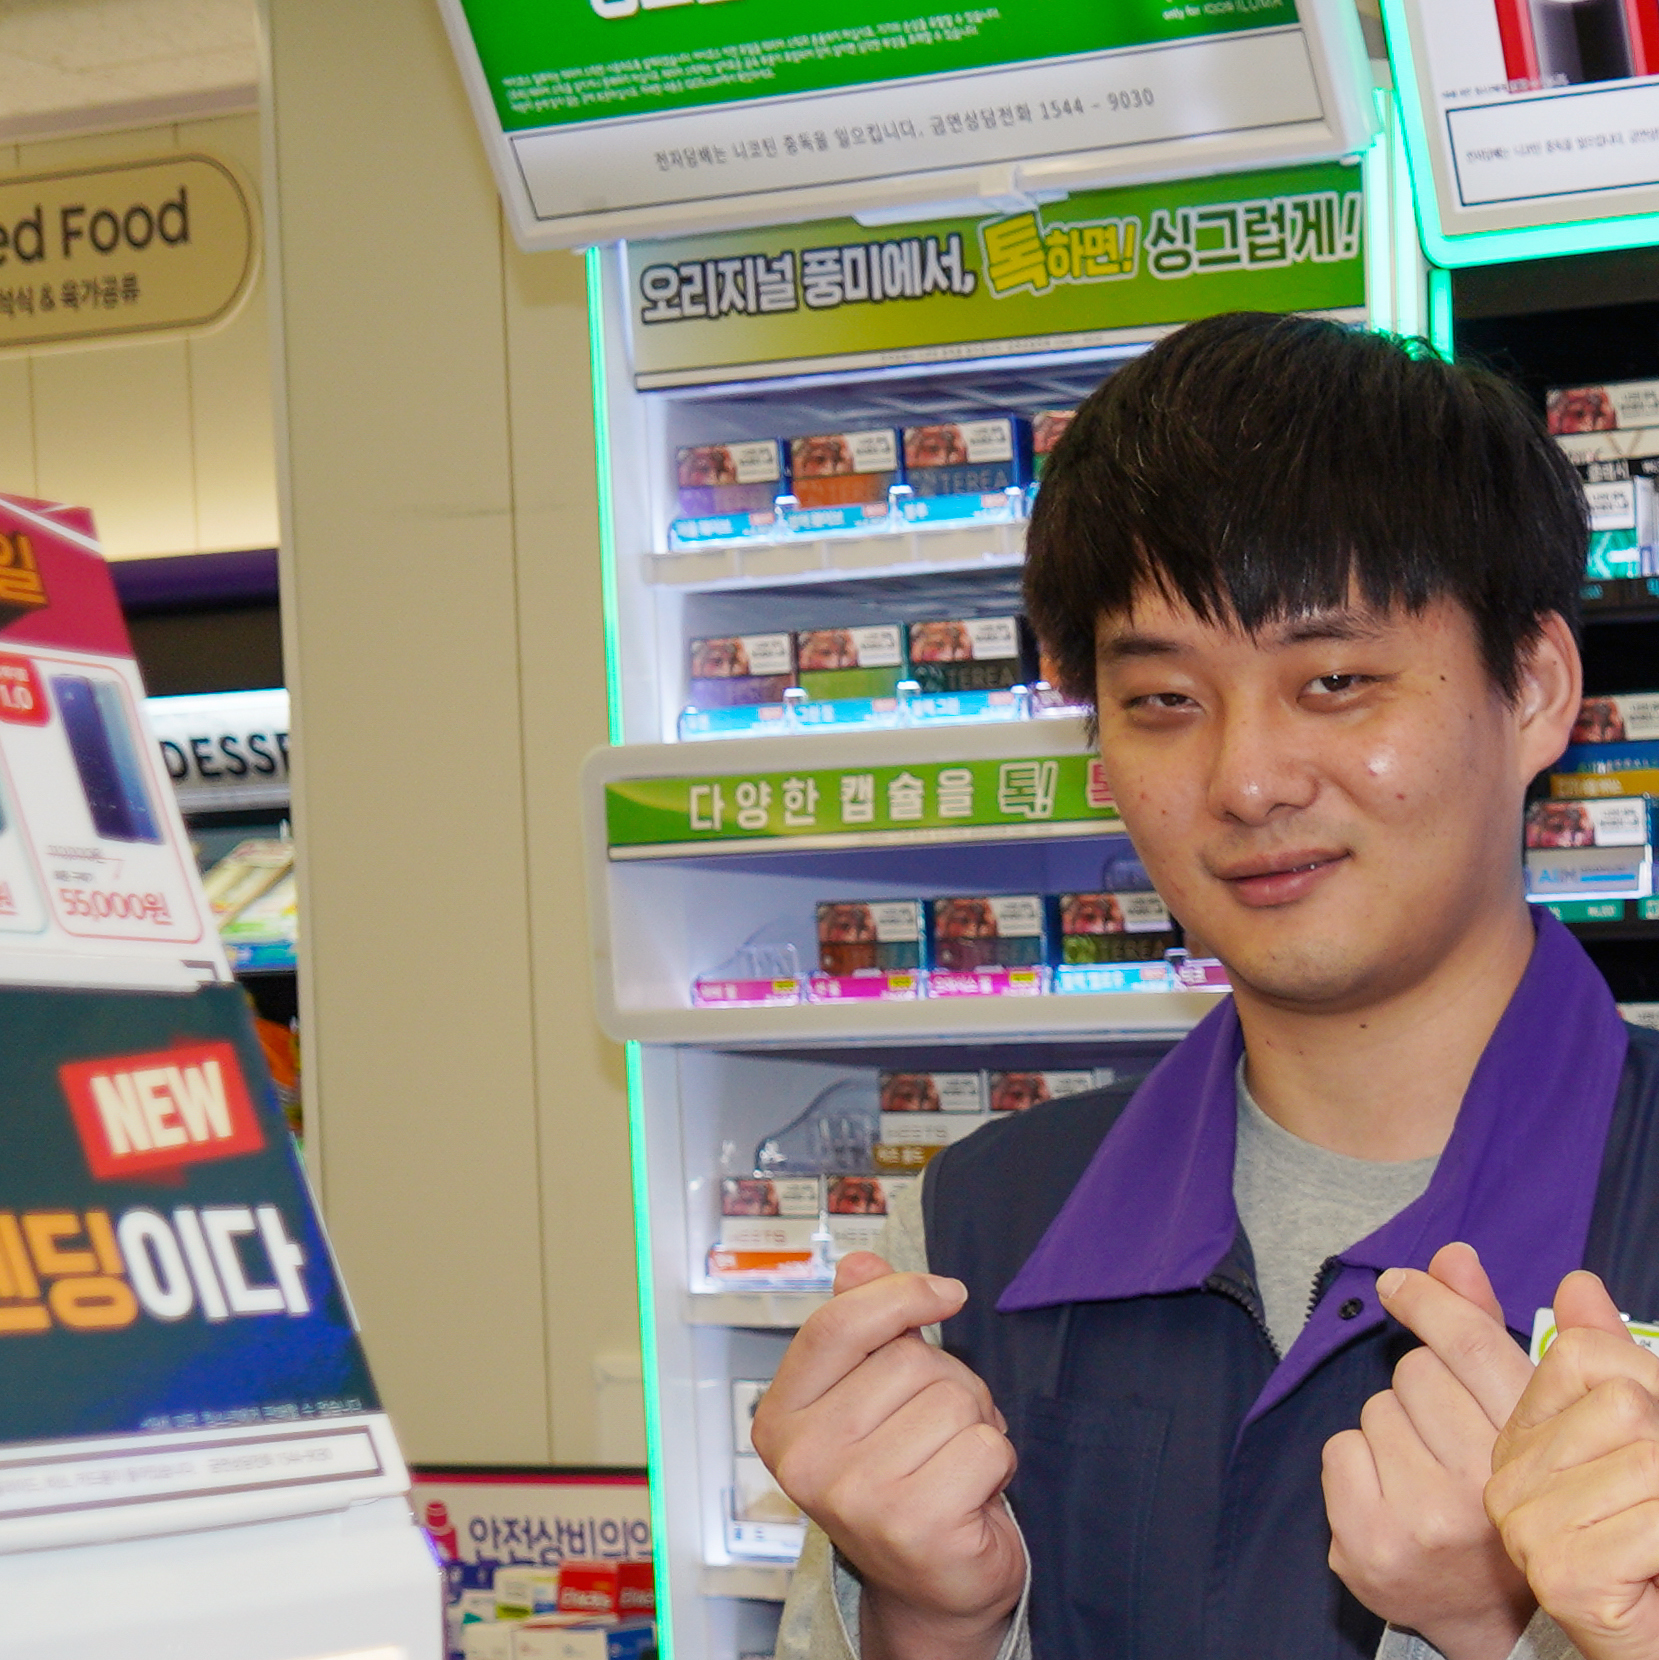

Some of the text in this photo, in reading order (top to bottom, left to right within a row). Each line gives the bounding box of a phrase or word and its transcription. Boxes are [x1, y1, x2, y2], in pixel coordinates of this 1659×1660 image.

[734, 136, 778, 160] 니코틴
[784, 130, 829, 156] 중독을
[835, 114, 924, 148] 일으킵니다.
[931, 97, 1032, 136] 금연상담전화
[1041, 93, 1084, 121] 1544
[1107, 86, 1155, 111] 9030
[60, 187, 191, 257] Food
[640, 250, 798, 323] 오리지널
[800, 231, 978, 311] 풍미에서,
[1146, 195, 1362, 280] 싱그럽게!
[688, 775, 820, 832] 다양한
[839, 766, 975, 822] 캡슐을
[90, 1059, 234, 1160] NEW
